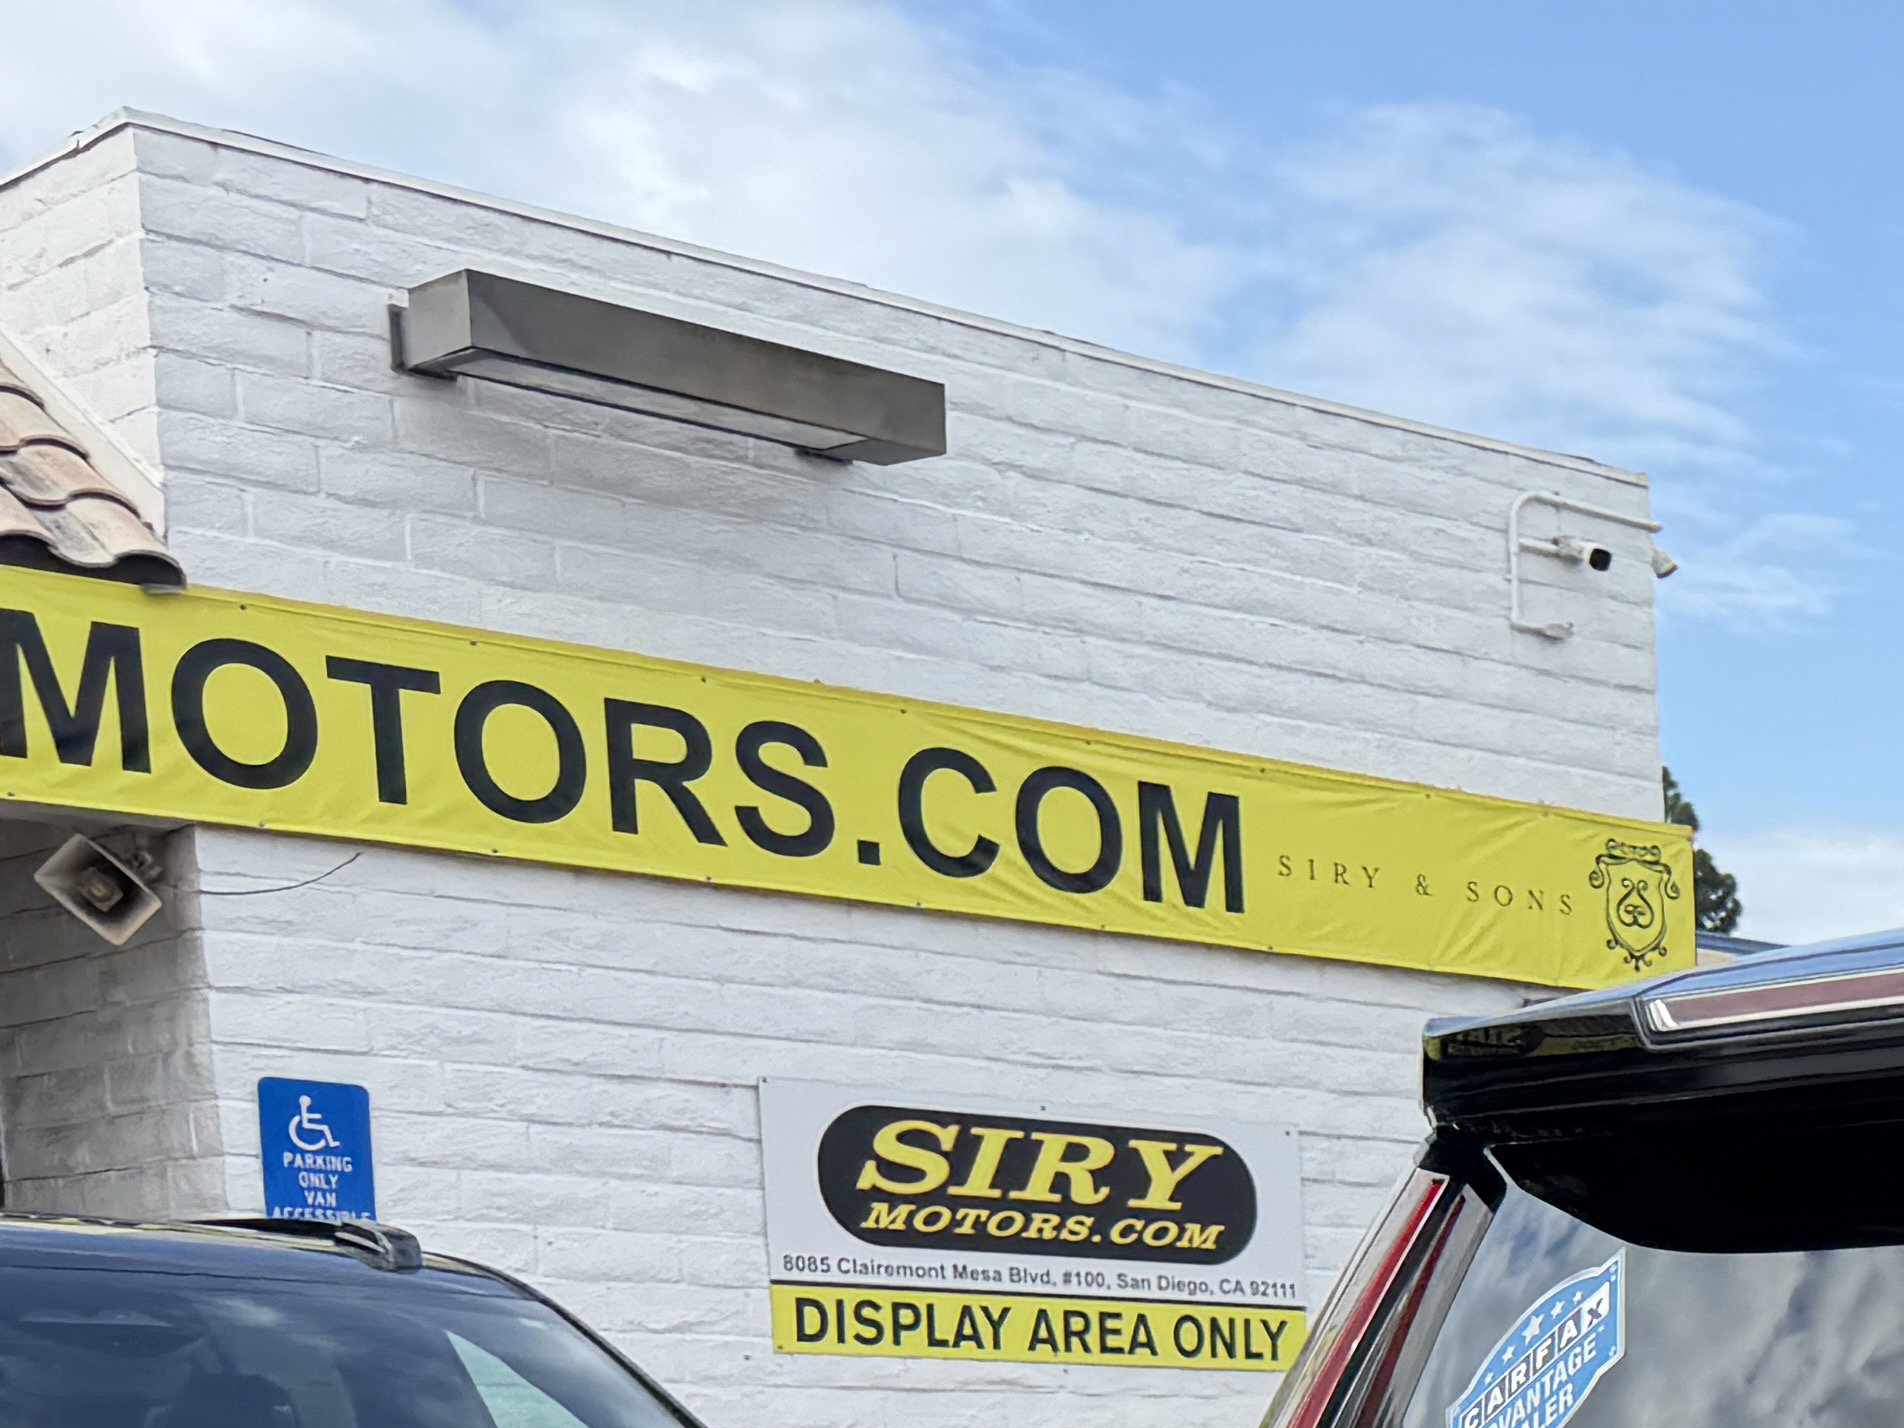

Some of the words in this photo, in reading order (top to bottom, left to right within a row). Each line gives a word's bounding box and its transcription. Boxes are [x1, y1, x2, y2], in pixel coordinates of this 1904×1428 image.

[0, 608, 1246, 914] MOTORS.COM
[1278, 855, 1381, 889] SIRY
[1415, 873, 1433, 897] &
[1466, 881, 1574, 916] SONS
[283, 1151, 353, 1172] PARKING
[298, 1171, 339, 1190] ONLY
[855, 1118, 1224, 1211] SIRY
[304, 1190, 337, 1208] VAN
[860, 1201, 1226, 1251] MOTORS.COM
[783, 1254, 831, 1274] 8085
[836, 1257, 947, 1280] Clairemont
[952, 1263, 1003, 1283] Mesa
[1062, 1271, 1111, 1290] #100,
[1116, 1272, 1151, 1290] San
[1157, 1275, 1214, 1296] Diego,
[1219, 1278, 1246, 1296] CA
[1249, 1281, 1297, 1299] 92111
[794, 1296, 1012, 1351] DISPLAY
[1027, 1308, 1159, 1358] AREA
[1173, 1314, 1288, 1361] ONLY
